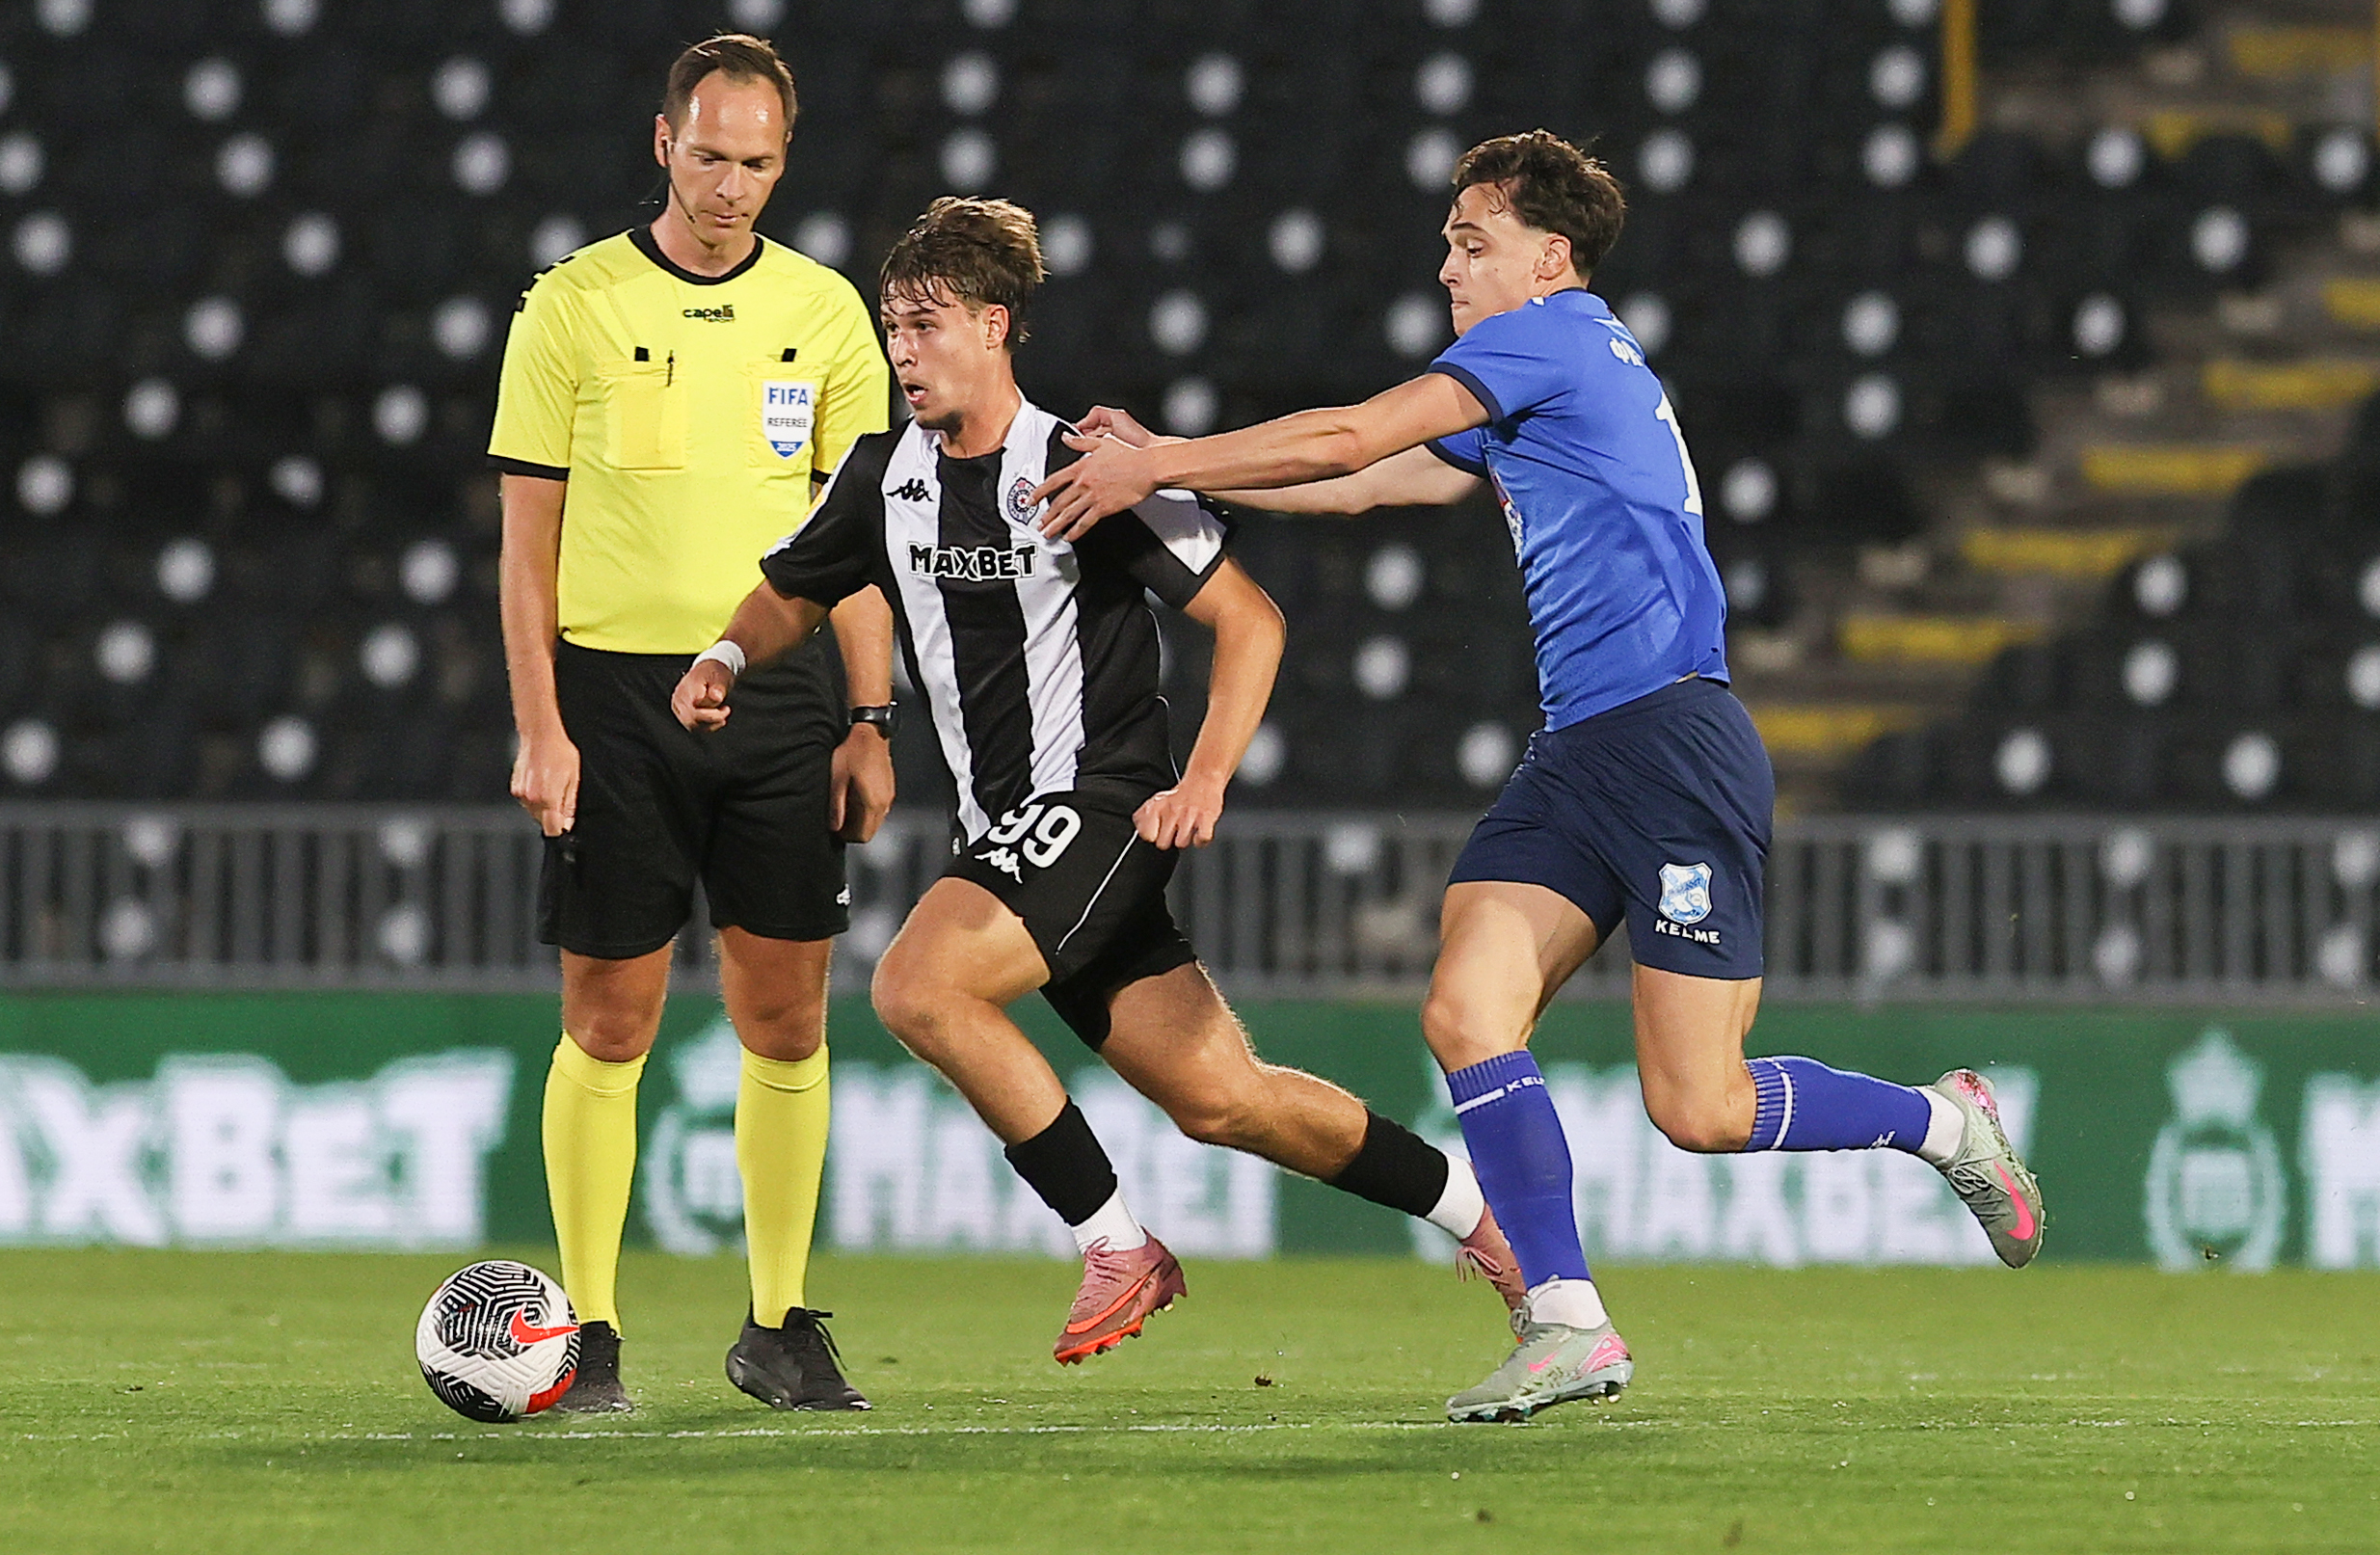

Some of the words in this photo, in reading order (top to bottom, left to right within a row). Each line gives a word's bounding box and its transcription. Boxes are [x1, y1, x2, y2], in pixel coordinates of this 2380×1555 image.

[768, 387, 809, 406] FIFA
[907, 541, 1037, 581] MAXBET
[987, 803, 1082, 869] 99
[1654, 919, 1722, 945] KELME
